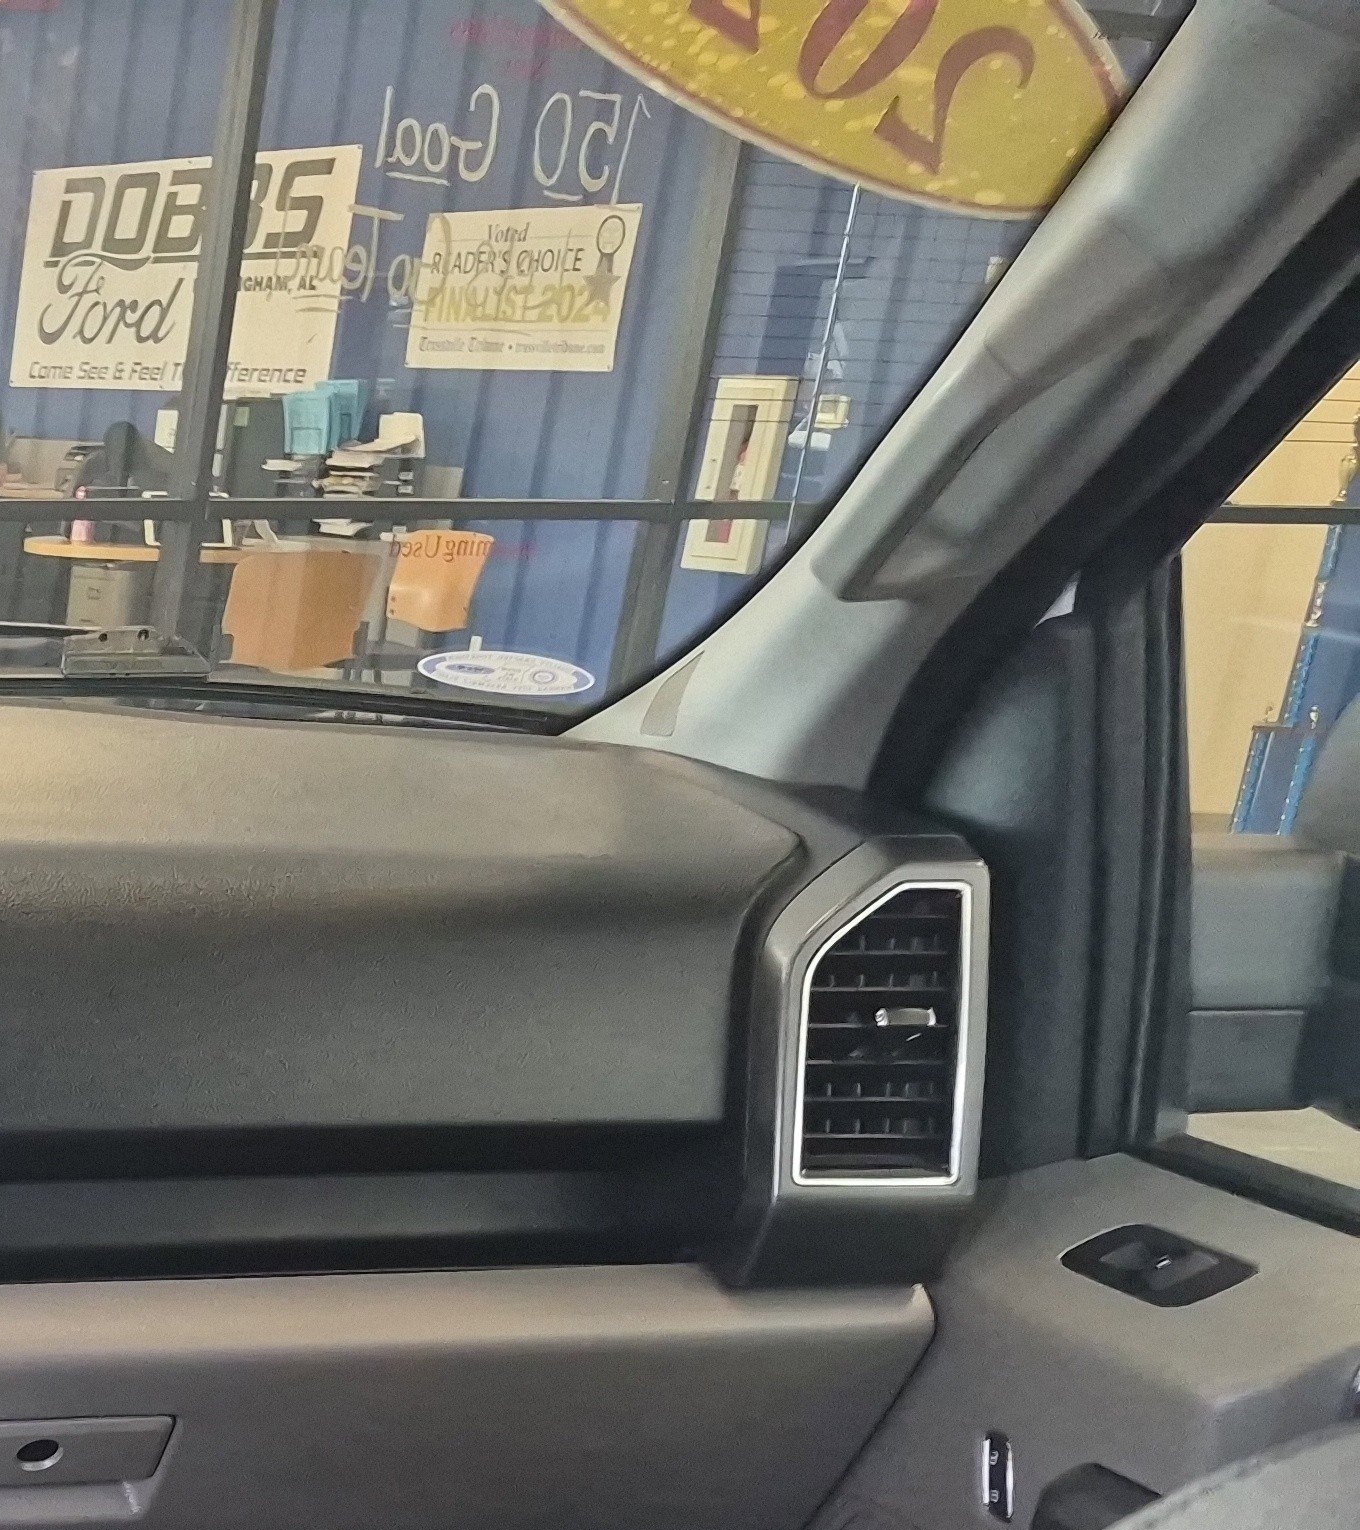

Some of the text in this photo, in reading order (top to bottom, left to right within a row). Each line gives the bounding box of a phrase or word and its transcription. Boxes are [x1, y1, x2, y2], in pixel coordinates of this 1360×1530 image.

[37, 252, 186, 345] Ford
[28, 362, 73, 380] Come
[76, 362, 108, 380] See
[112, 362, 125, 381] &
[129, 363, 167, 381] Feel
